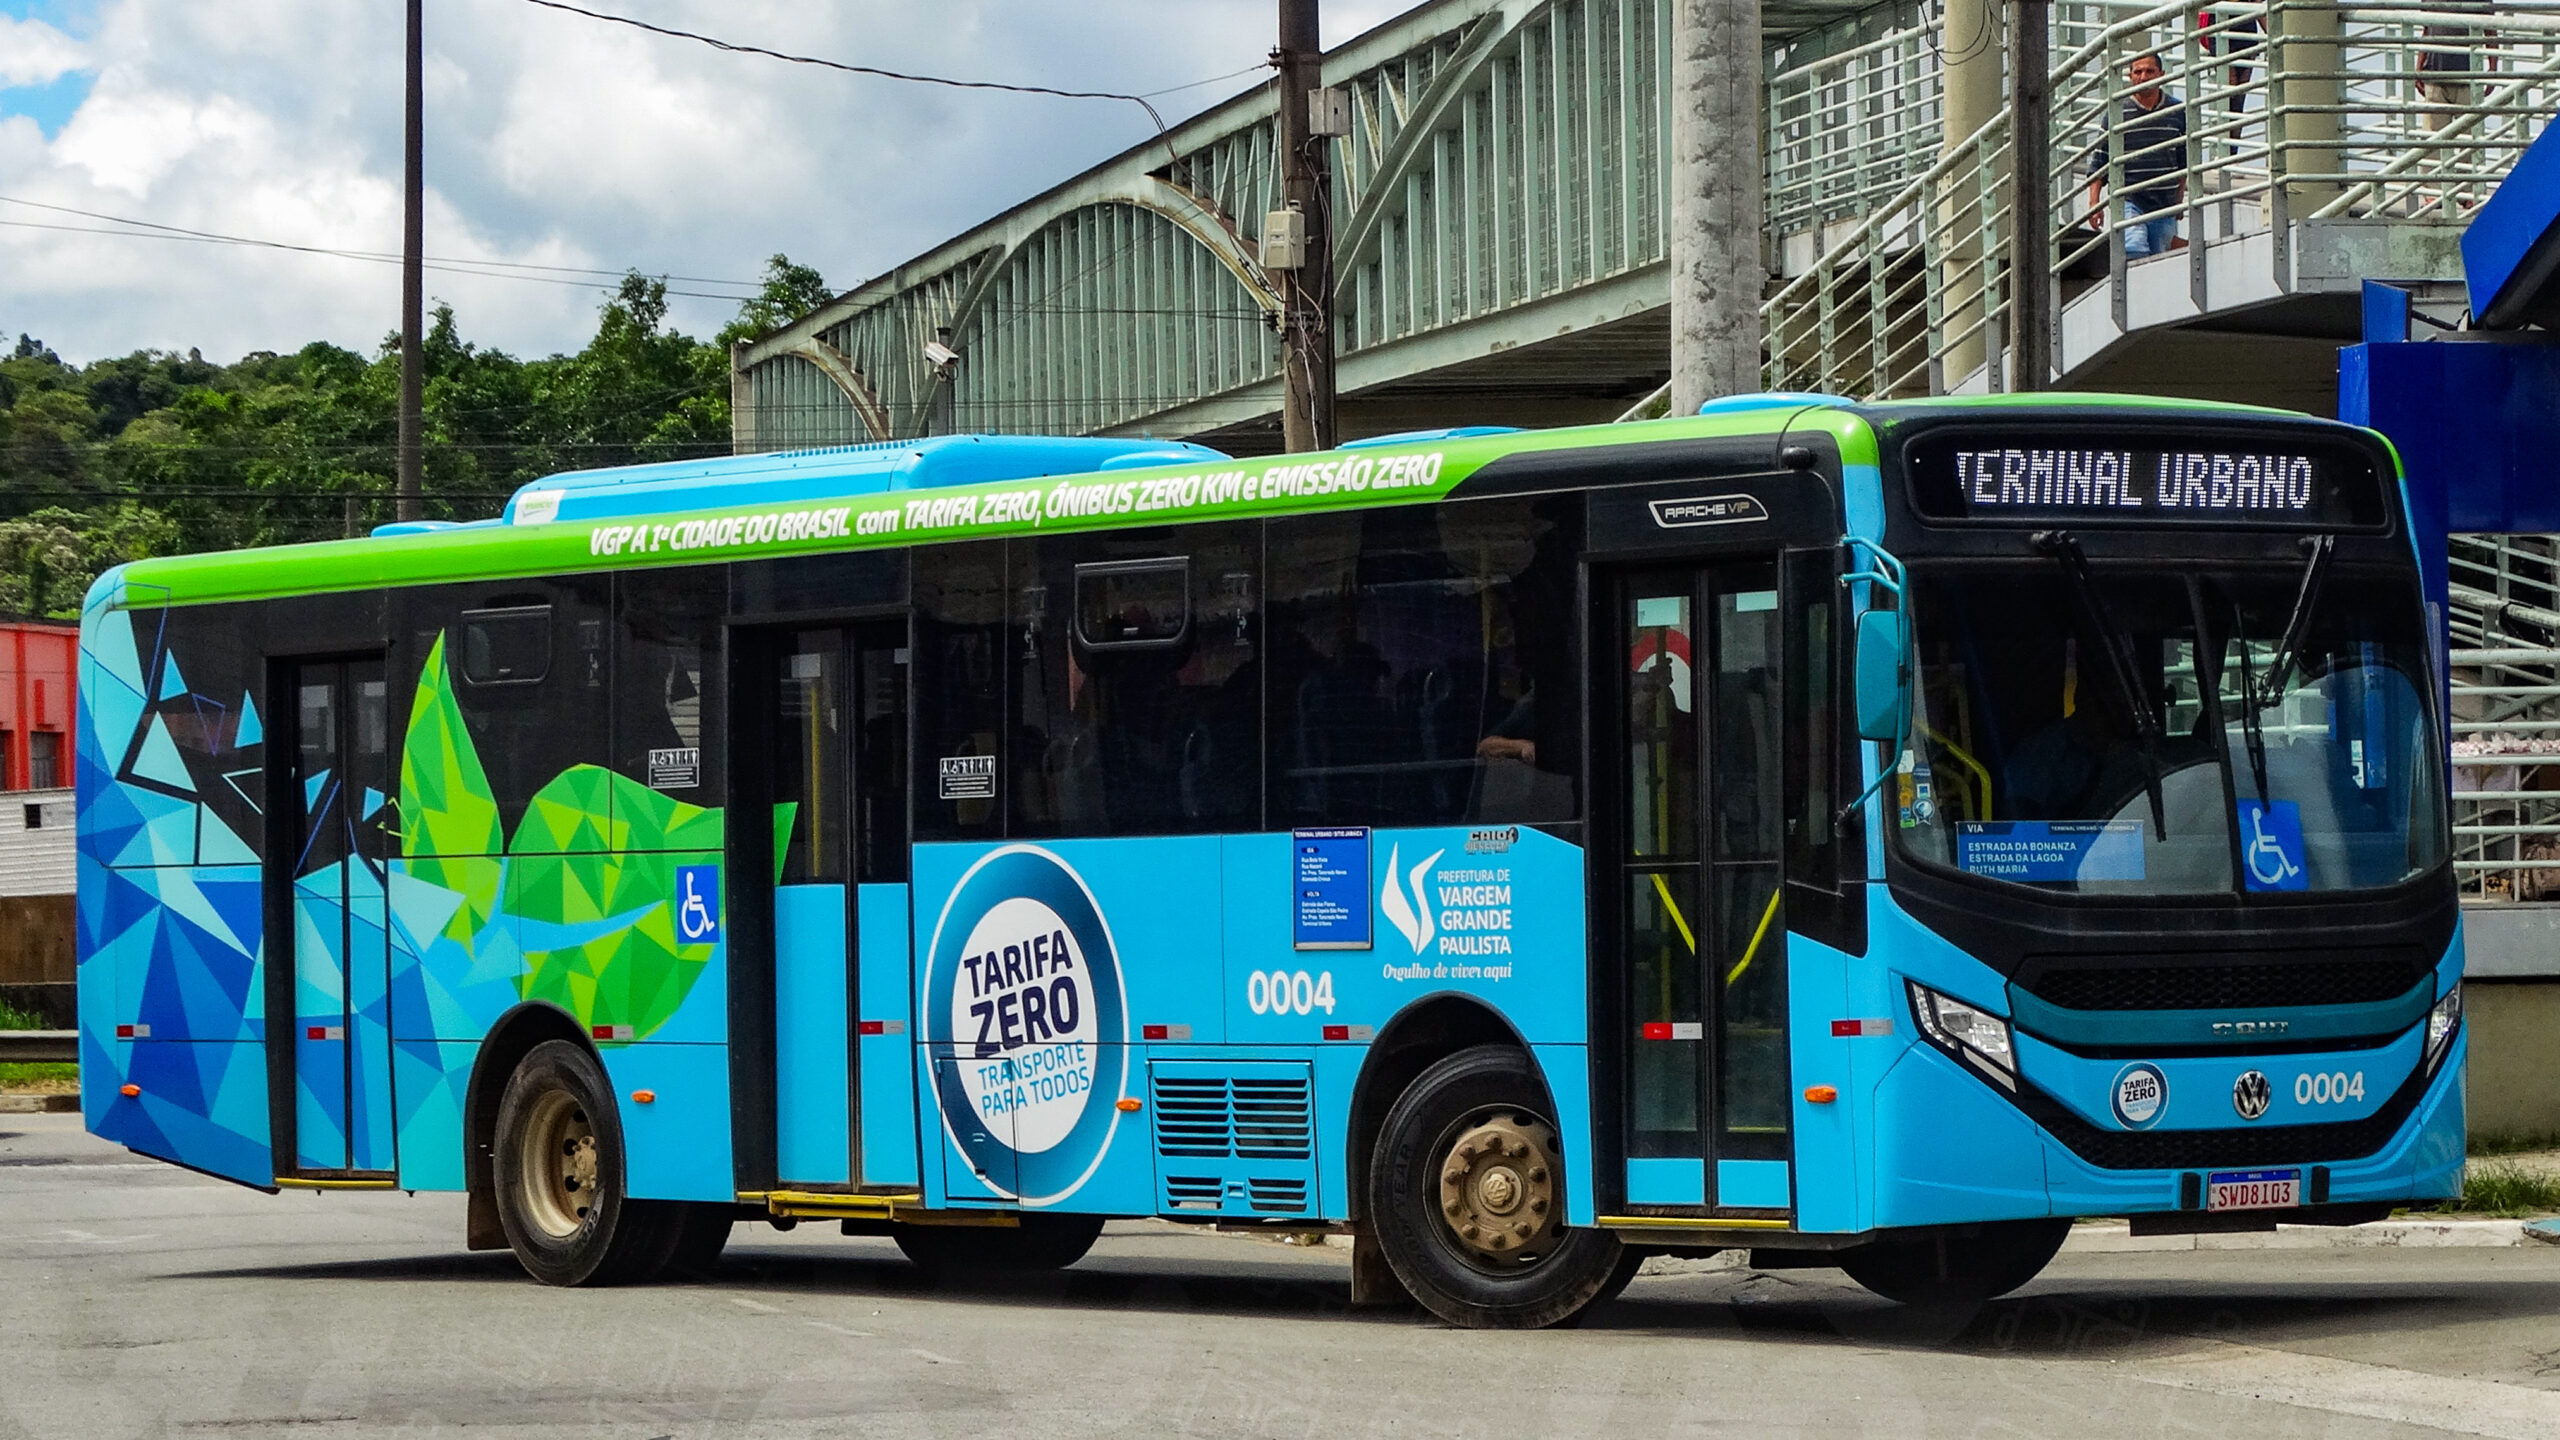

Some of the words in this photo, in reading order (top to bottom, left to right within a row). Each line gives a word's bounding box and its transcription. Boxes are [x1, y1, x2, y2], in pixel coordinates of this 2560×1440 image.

[1956, 449, 2142, 505] TERMINAL
[2158, 453, 2312, 509] URBANO
[590, 524, 632, 556] VGP
[630, 522, 646, 553] A
[670, 516, 746, 550] CIDADE
[745, 514, 779, 544] DO
[777, 508, 850, 541] BRASIL
[856, 508, 899, 536] com
[905, 496, 977, 530] TARIFA
[980, 490, 1041, 527] ZERO,
[1047, 481, 1137, 518] ÔNIBUS
[1135, 474, 1200, 512] ZERO
[1201, 471, 1240, 505] KM
[1243, 477, 1257, 500] e
[1260, 459, 1368, 499] EMISSÃO
[1369, 453, 1443, 490] ZERO
[1665, 504, 1726, 519] APACHE
[1727, 501, 1750, 514] VIP
[1967, 824, 1984, 833] VIA
[1968, 842, 2013, 852] ESTRADA
[2015, 842, 2029, 851] DA
[2030, 841, 2076, 851] BONANZA
[1969, 853, 2014, 863] ESTRADA
[2015, 853, 2029, 862] DA
[2030, 853, 2064, 863] LAGOA
[1437, 870, 1494, 883] PREFEITURA
[1497, 869, 1510, 882] DE
[1969, 865, 1995, 874] RUTH
[1997, 864, 2028, 873] MARIA
[1438, 885, 1511, 907] VARGEM
[1441, 909, 1512, 930] GRANDE
[1439, 936, 1512, 956] PAULISTA
[963, 929, 1073, 998] TARIFA
[1383, 963, 1431, 982] Orgulho
[1433, 962, 1448, 979] de
[1451, 963, 1481, 979] viver
[1484, 961, 1512, 983] aqui
[1248, 969, 1336, 1015] 0004
[970, 976, 1079, 1058] ZERO
[977, 1039, 1087, 1090] TRANSPORTE
[981, 1085, 1028, 1119] PARA
[1029, 1067, 1091, 1104] TODOS
[2124, 1077, 2155, 1090] TARIFA
[2124, 1086, 2156, 1102] ZERO
[2294, 1071, 2365, 1105] 0004
